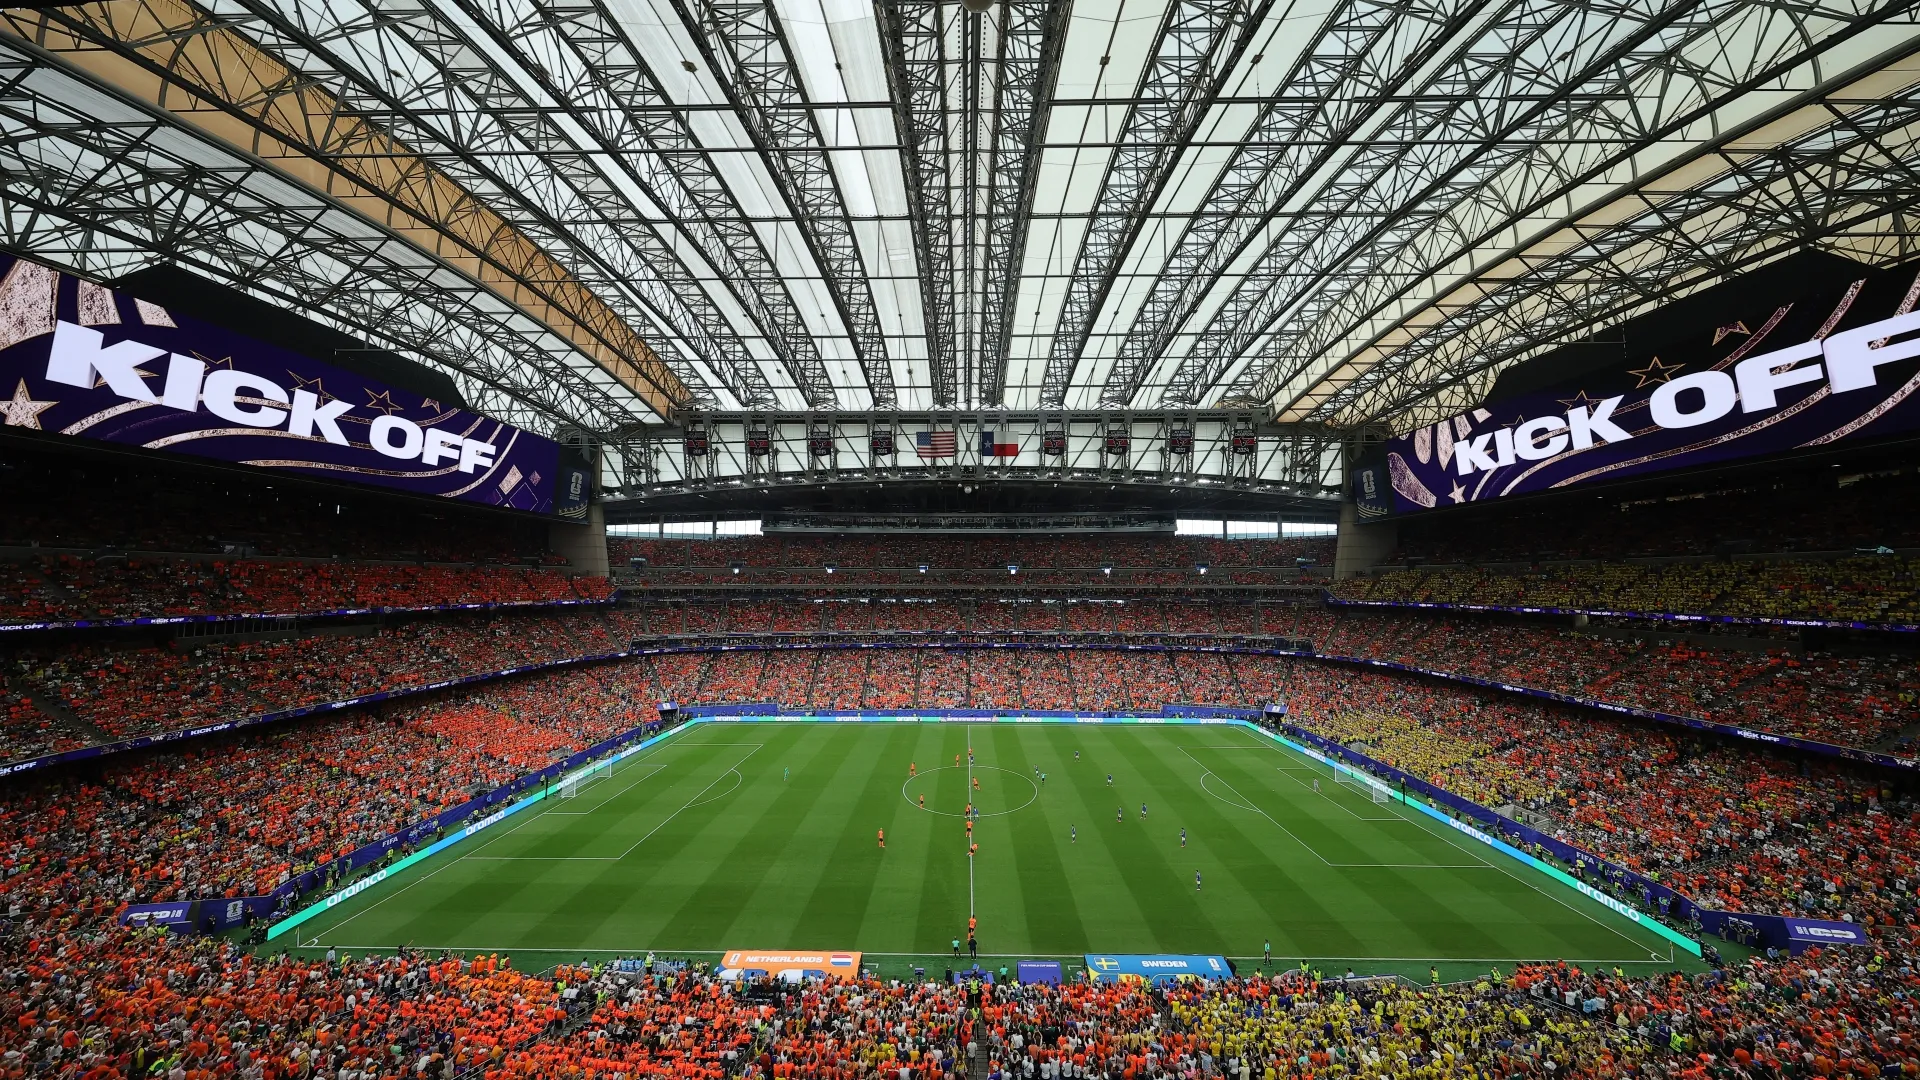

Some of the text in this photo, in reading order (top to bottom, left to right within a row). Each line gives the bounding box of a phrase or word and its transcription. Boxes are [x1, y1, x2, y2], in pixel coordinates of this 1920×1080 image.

[45, 319, 497, 475] KICK OFF
[1453, 309, 1920, 477] KICK OFF
[190, 727, 212, 736] KICK
[1737, 730, 1780, 742] KICK OFF
[13, 761, 37, 772] OFF
[465, 810, 505, 836] aramco
[1450, 818, 1493, 845] aramco
[382, 836, 399, 848] FIFA
[1576, 851, 1595, 865] FIFA
[326, 869, 387, 908] aramco
[1576, 880, 1640, 922] aramco
[744, 955, 824, 963] NETHERLANDS
[1141, 960, 1188, 968] SWEDEN
